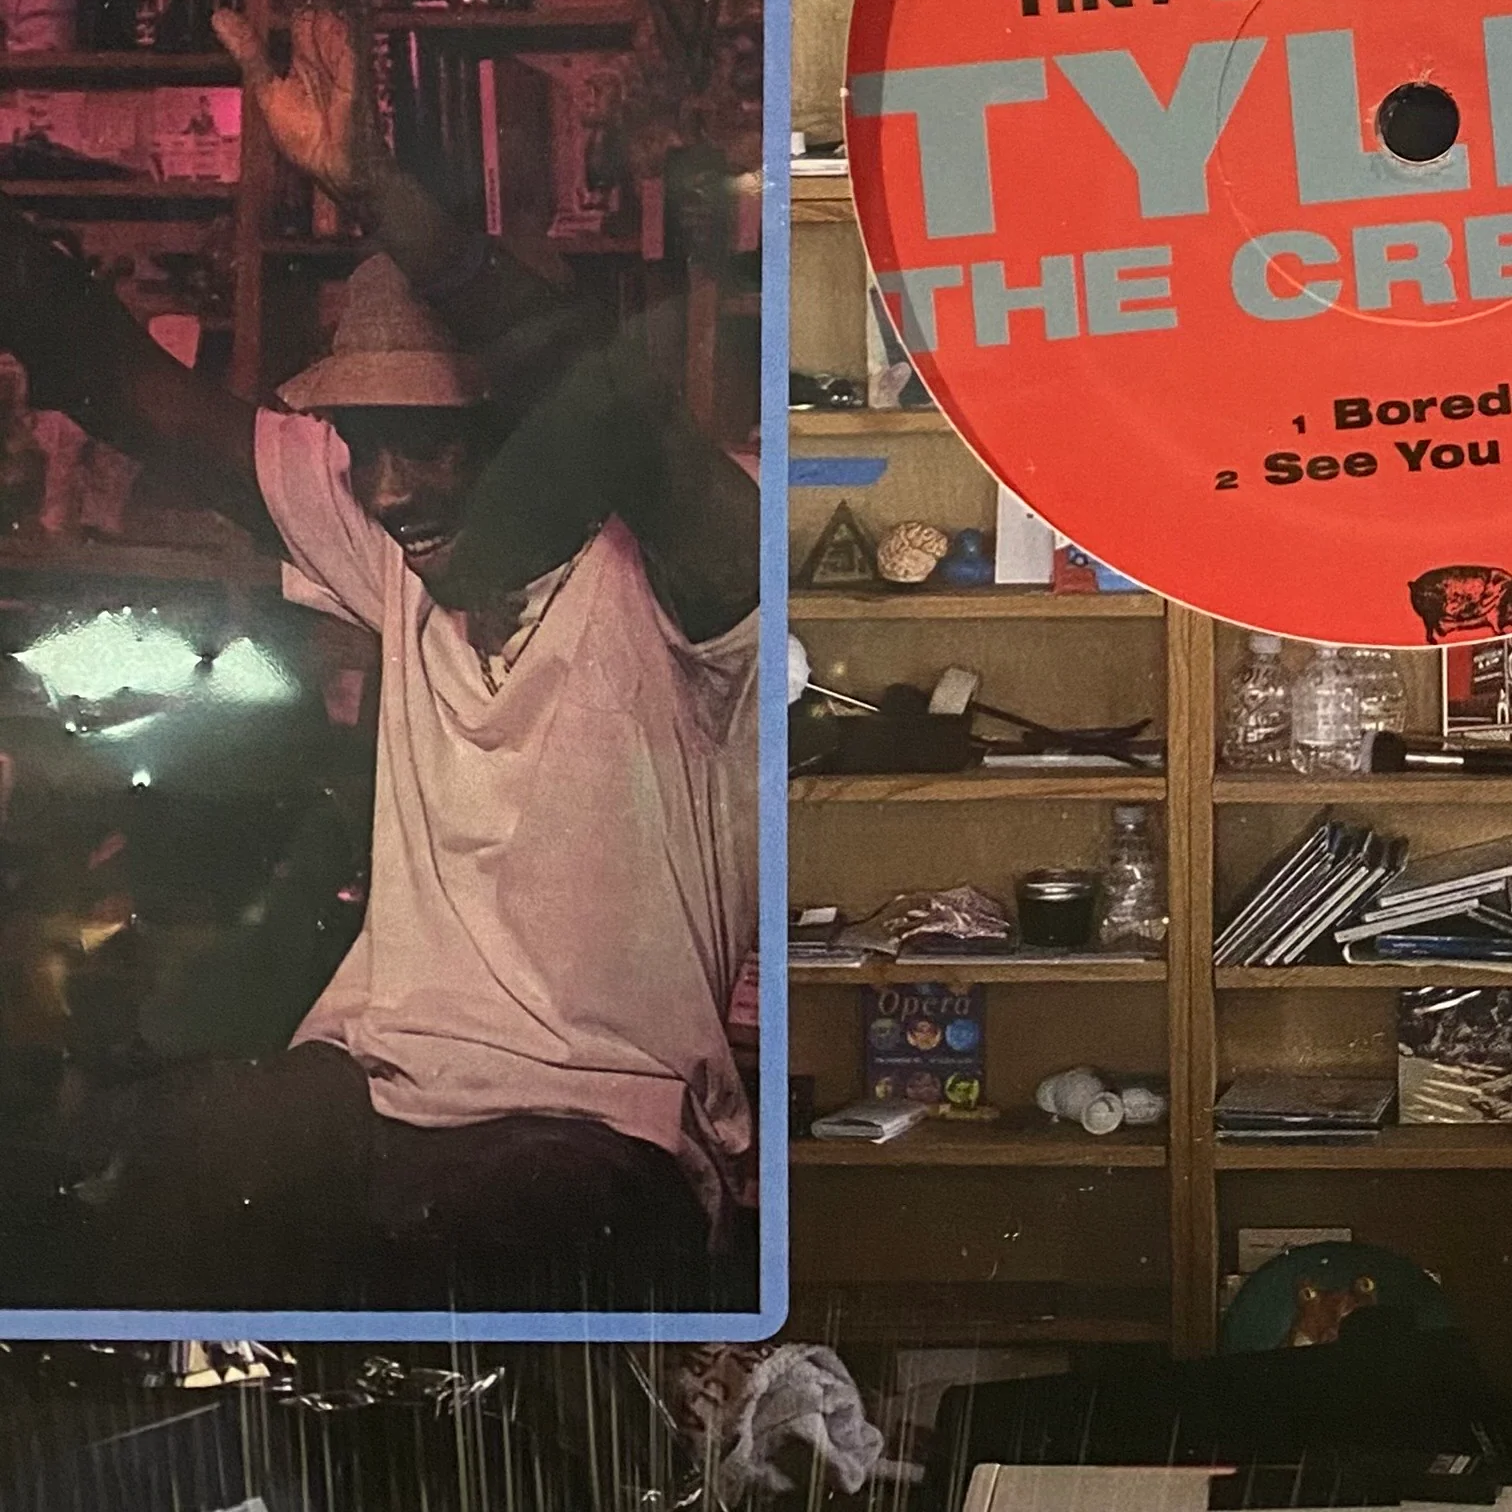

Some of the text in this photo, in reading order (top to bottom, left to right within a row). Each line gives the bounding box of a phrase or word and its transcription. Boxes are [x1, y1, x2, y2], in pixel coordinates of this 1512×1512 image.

[872, 244, 1180, 355] THE
[1292, 415, 1306, 435] 1
[1214, 470, 1239, 491] 2
[1263, 450, 1379, 487] See
[1394, 436, 1503, 475] You
[878, 990, 972, 1021] Opera
